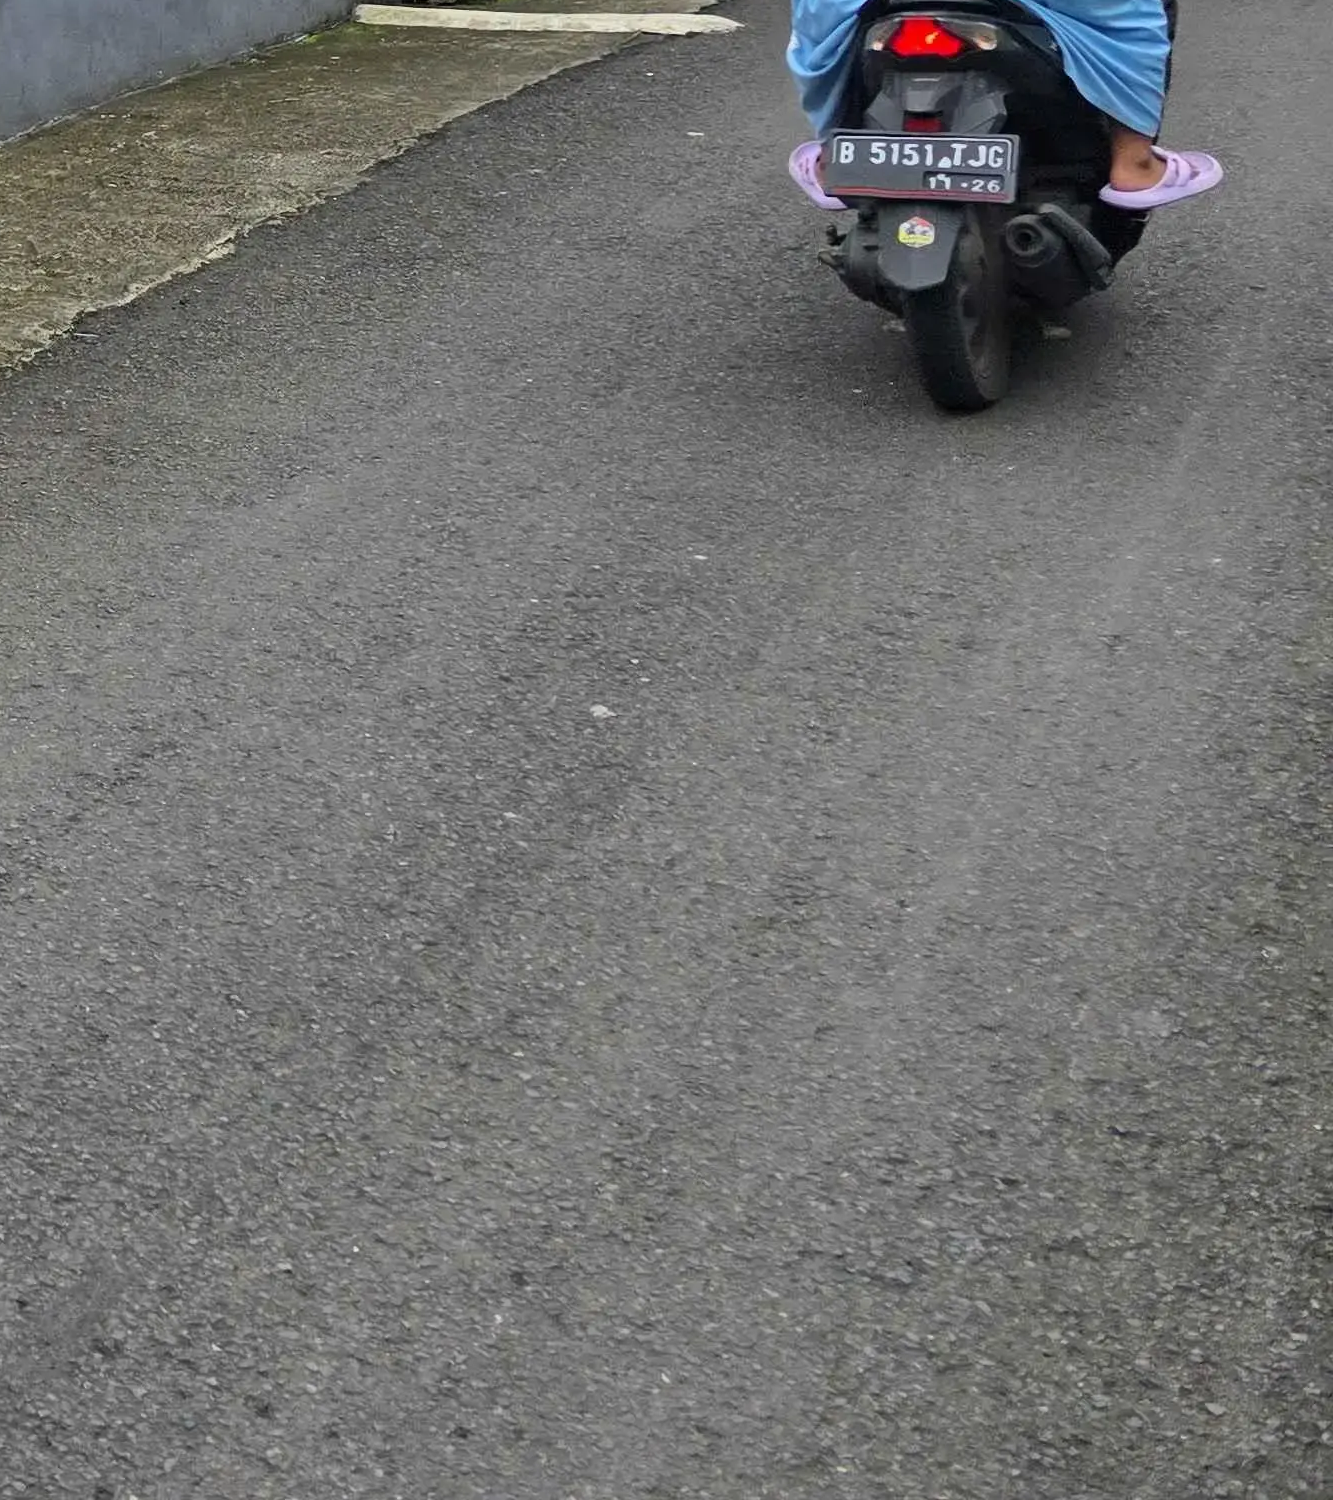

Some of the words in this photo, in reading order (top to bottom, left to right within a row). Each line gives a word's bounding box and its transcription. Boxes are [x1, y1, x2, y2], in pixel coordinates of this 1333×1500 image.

[839, 141, 855, 165] B
[869, 143, 933, 167] 5151
[950, 143, 1005, 168] TJG
